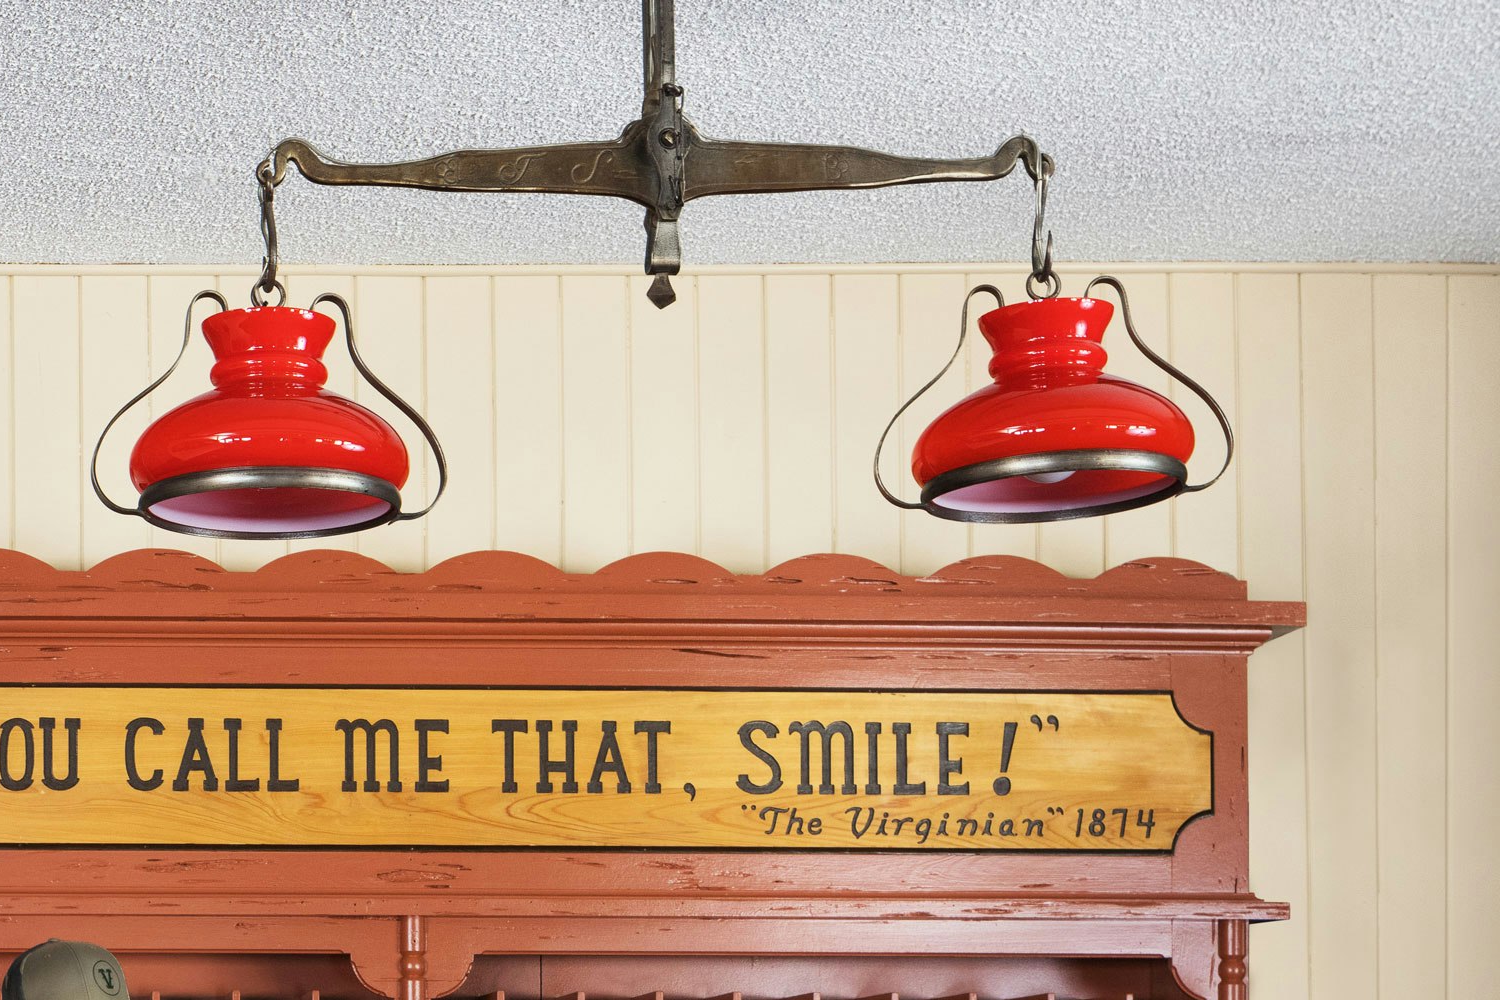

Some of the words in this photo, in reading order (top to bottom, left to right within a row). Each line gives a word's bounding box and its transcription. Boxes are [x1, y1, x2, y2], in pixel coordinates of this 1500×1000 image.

[123, 716, 301, 794] CALL
[333, 717, 451, 794] ME
[490, 718, 698, 802] THAT,
[740, 803, 824, 837] "The
[843, 804, 1066, 845] Virginian"
[1074, 807, 1158, 840] 1874
[98, 968, 114, 990] V
